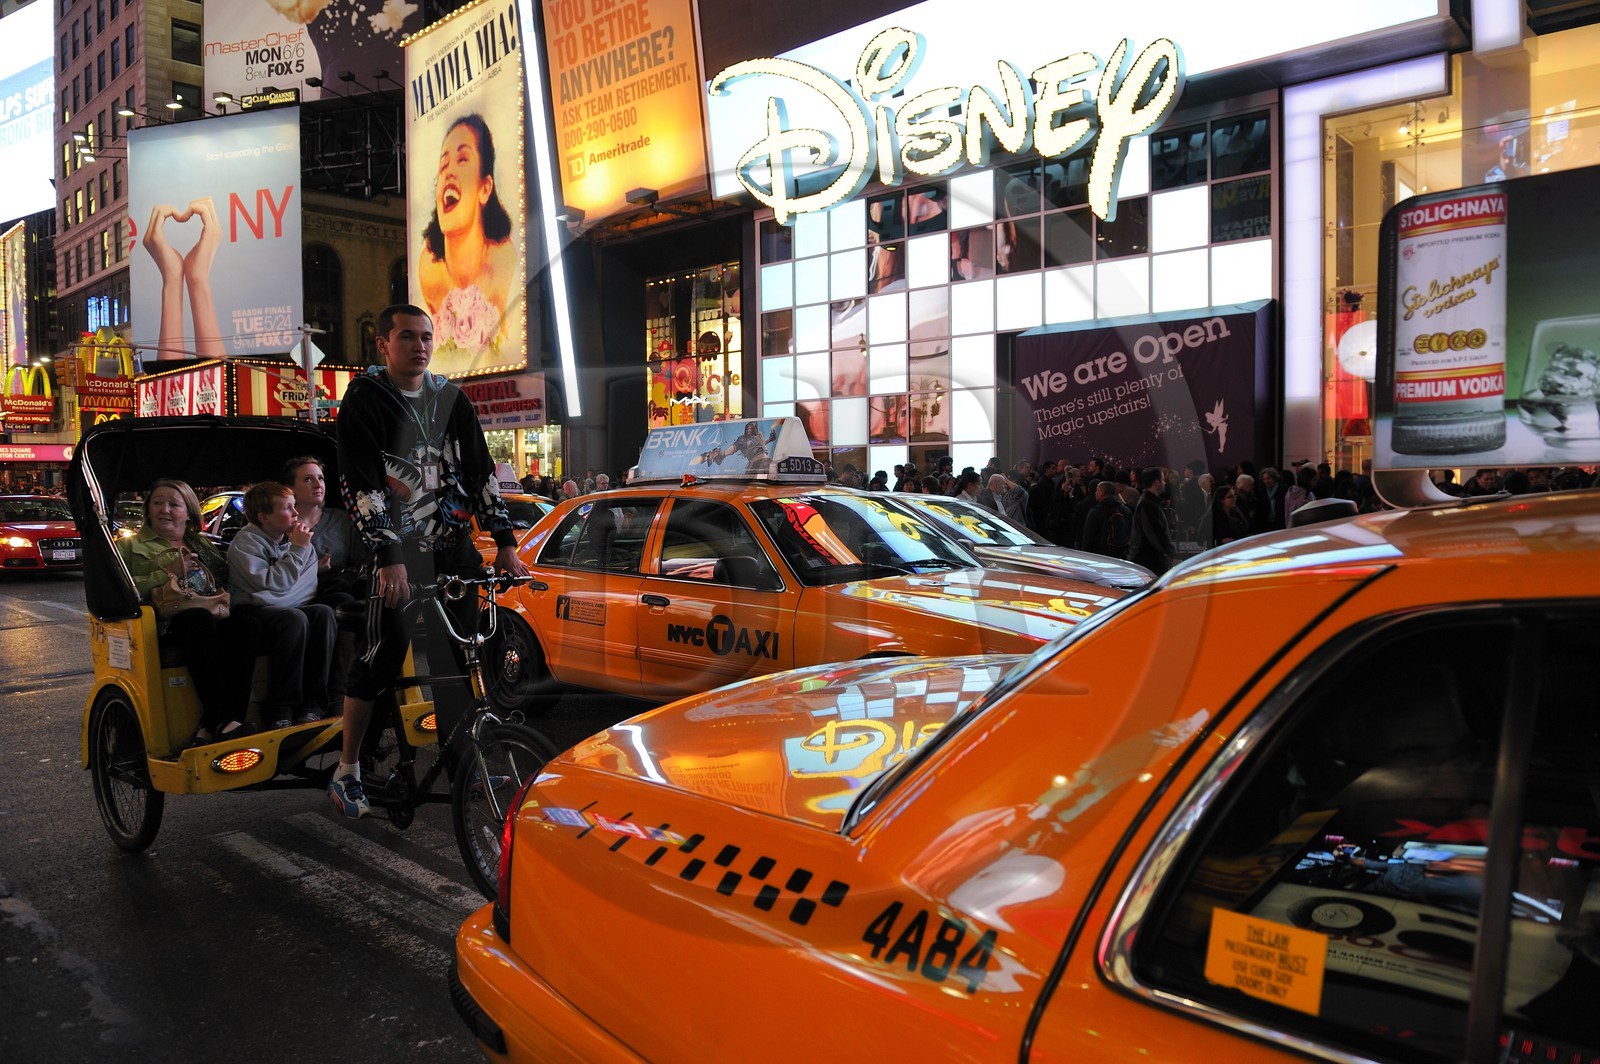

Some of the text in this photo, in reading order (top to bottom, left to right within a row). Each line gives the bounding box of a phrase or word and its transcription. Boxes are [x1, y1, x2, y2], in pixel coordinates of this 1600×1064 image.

[553, 0, 652, 70] TO RETIRE
[245, 42, 305, 66] MON 6/6
[267, 60, 293, 78] FOX
[295, 59, 305, 73] 5
[412, 3, 517, 122] MAMMA MIA!
[560, 25, 675, 106] ANYWHERE?
[562, 62, 691, 134] ASK TEAM RETIREMENT.
[563, 106, 638, 150] 800-290-0500
[262, 145, 274, 153] the
[588, 134, 651, 165] Ameritrade
[229, 184, 294, 243] NY
[1400, 197, 1505, 229] STOLICHNAYA
[1401, 256, 1500, 321] Stolichnaya
[232, 305, 292, 318] SEASON FINALE
[232, 316, 264, 334] TUE
[255, 331, 282, 348] FOX
[283, 330, 293, 346] 5
[1021, 317, 1231, 401] We are Open
[4, 399, 53, 407] McDonald's
[1033, 363, 1185, 423] There's still plenty of
[1396, 374, 1504, 399] PREMIUM VODKA
[1037, 394, 1152, 441] Magic upstairs!
[646, 427, 709, 450] BRINK
[790, 458, 812, 472] 5D13
[667, 619, 779, 660] NYC TAXI
[862, 901, 998, 995] 4A84
[1246, 924, 1291, 952] THE LAW
[1225, 939, 1277, 964] PASSENGERS
[1278, 952, 1308, 975] MUST
